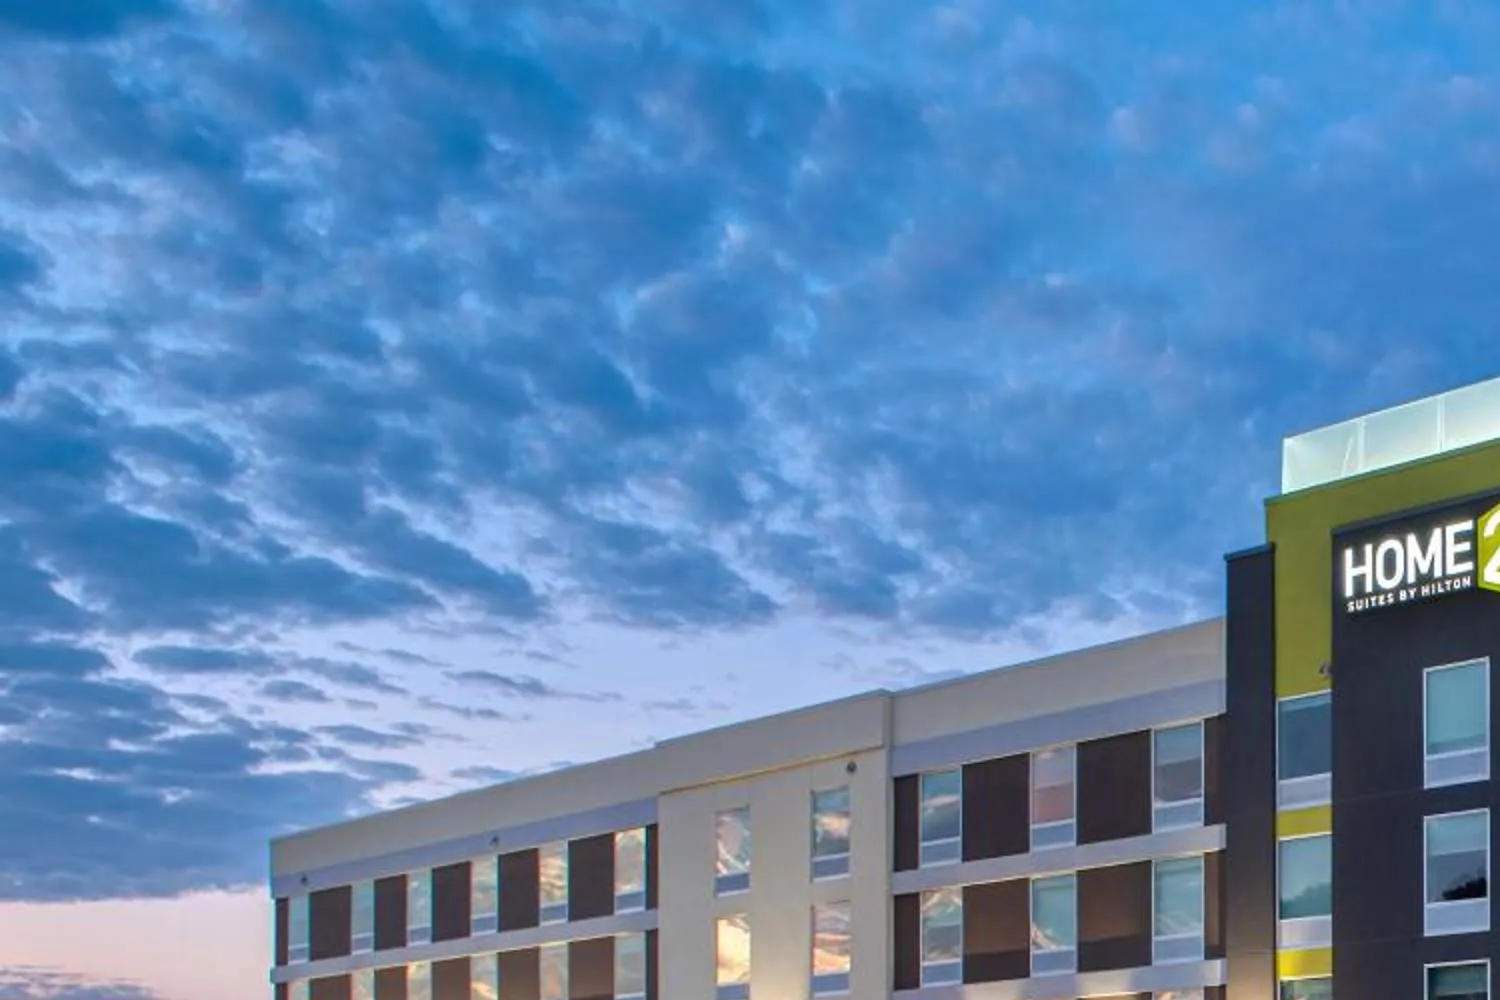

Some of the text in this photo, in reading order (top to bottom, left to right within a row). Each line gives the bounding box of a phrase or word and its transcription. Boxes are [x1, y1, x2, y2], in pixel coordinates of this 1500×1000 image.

[1344, 519, 1473, 597] HOME
[1346, 575, 1472, 613] SUITES BY HILTON
